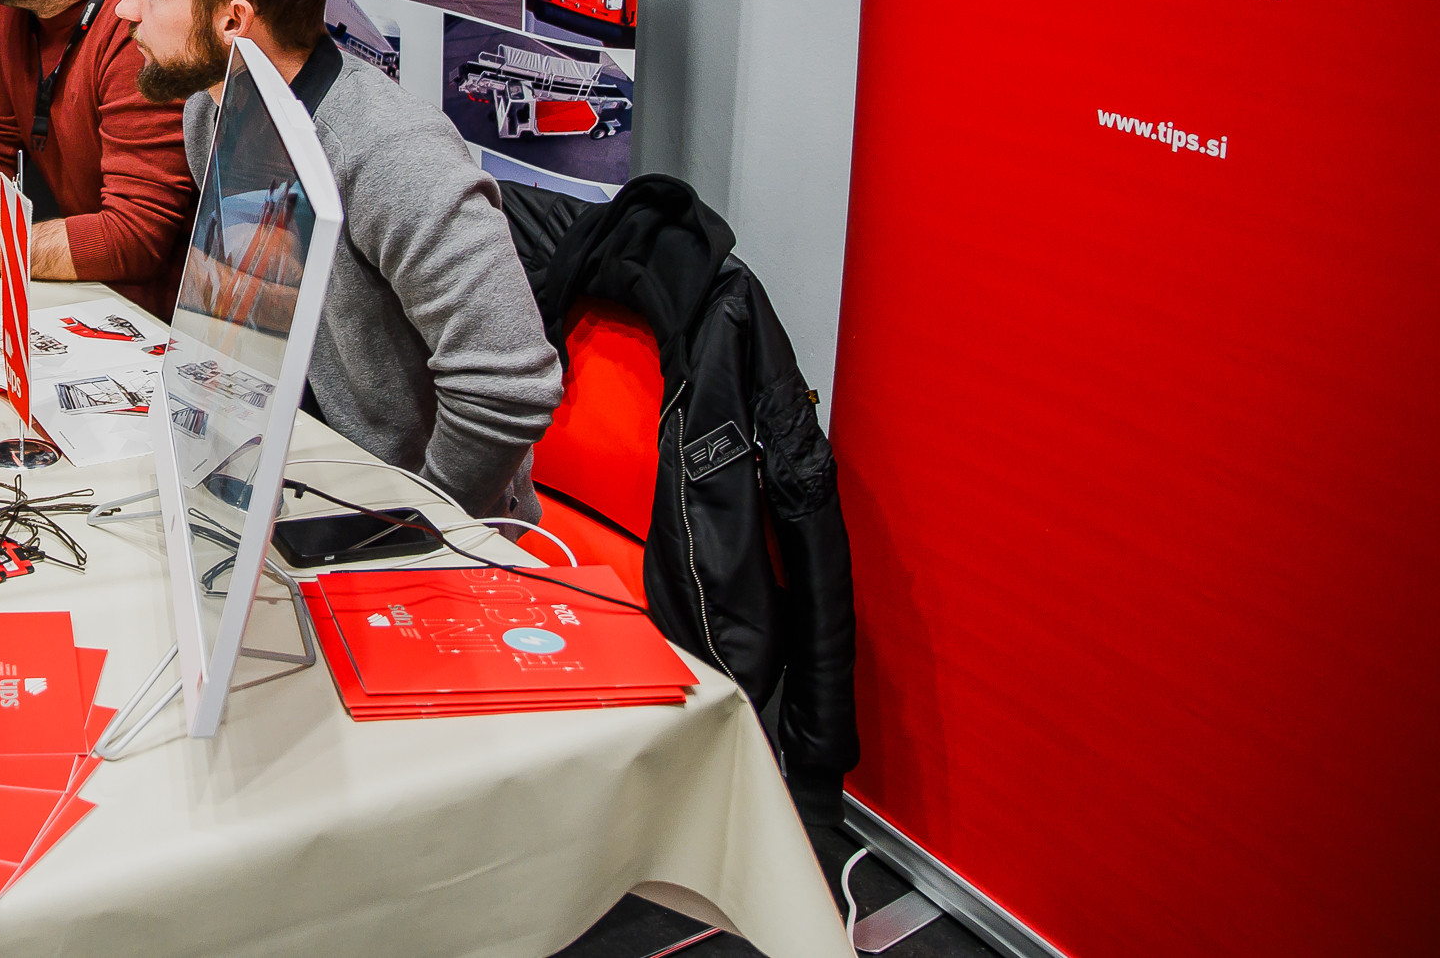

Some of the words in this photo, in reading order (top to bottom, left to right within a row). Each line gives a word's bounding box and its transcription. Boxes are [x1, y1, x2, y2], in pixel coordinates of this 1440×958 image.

[1098, 109, 1228, 160] www.tips.si
[388, 604, 414, 627] tips
[550, 603, 581, 626] 2024
